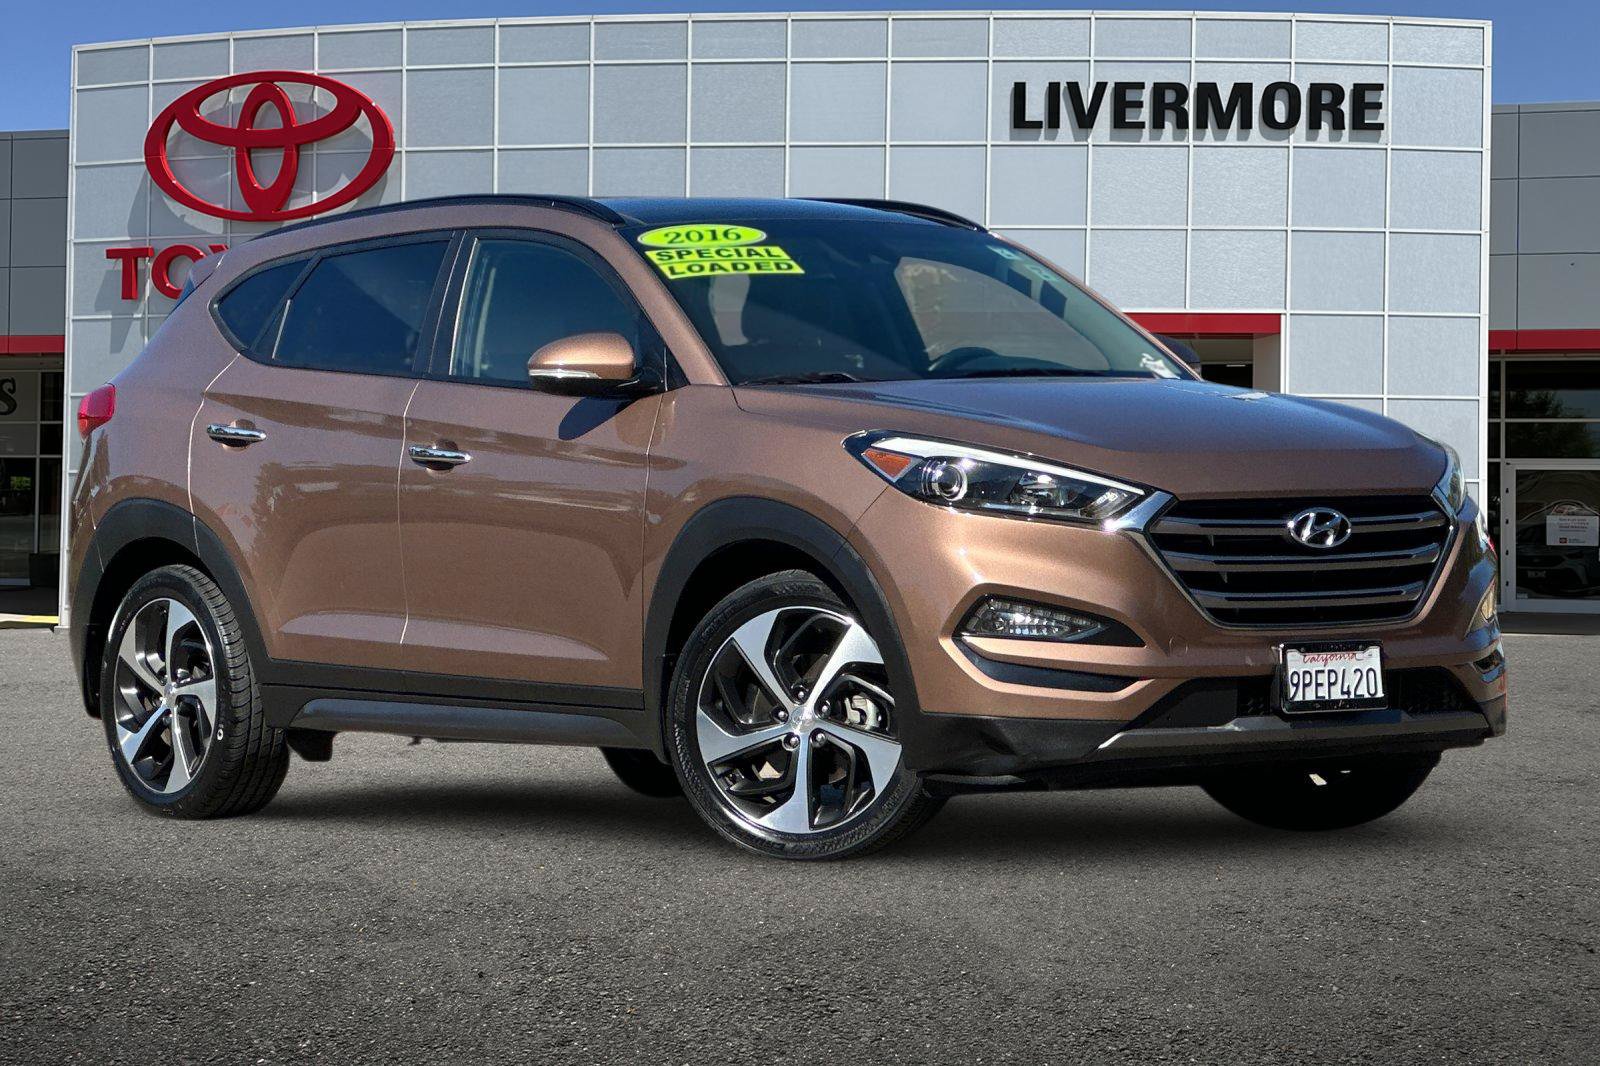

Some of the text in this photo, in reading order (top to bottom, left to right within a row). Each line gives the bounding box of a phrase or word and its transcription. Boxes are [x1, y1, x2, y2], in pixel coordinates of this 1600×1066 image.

[1012, 81, 1385, 131] LIVERMORE
[664, 227, 742, 244] 2016
[655, 246, 782, 262] SPECIAL
[106, 244, 229, 300] TO
[667, 261, 794, 276] LOADED
[1289, 667, 1379, 701] 9PEP420
